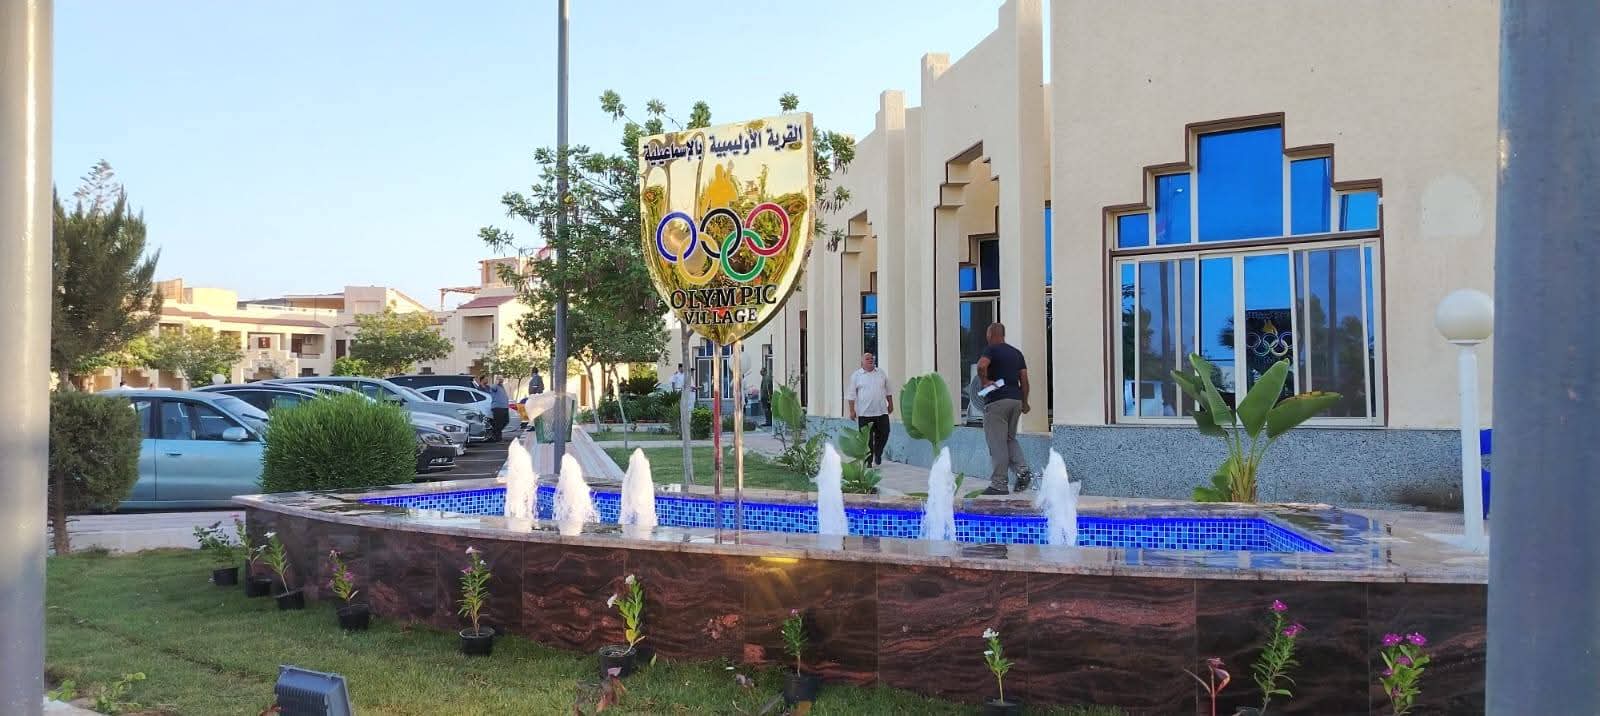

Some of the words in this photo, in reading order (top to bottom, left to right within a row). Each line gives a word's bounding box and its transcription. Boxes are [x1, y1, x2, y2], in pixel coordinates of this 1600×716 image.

[709, 131, 761, 157] الأوليمبية
[766, 123, 803, 150] القرية
[643, 139, 703, 165] بالإسماعيلية
[671, 284, 777, 309] OLYMPIC
[684, 307, 757, 325] VILLAGE
